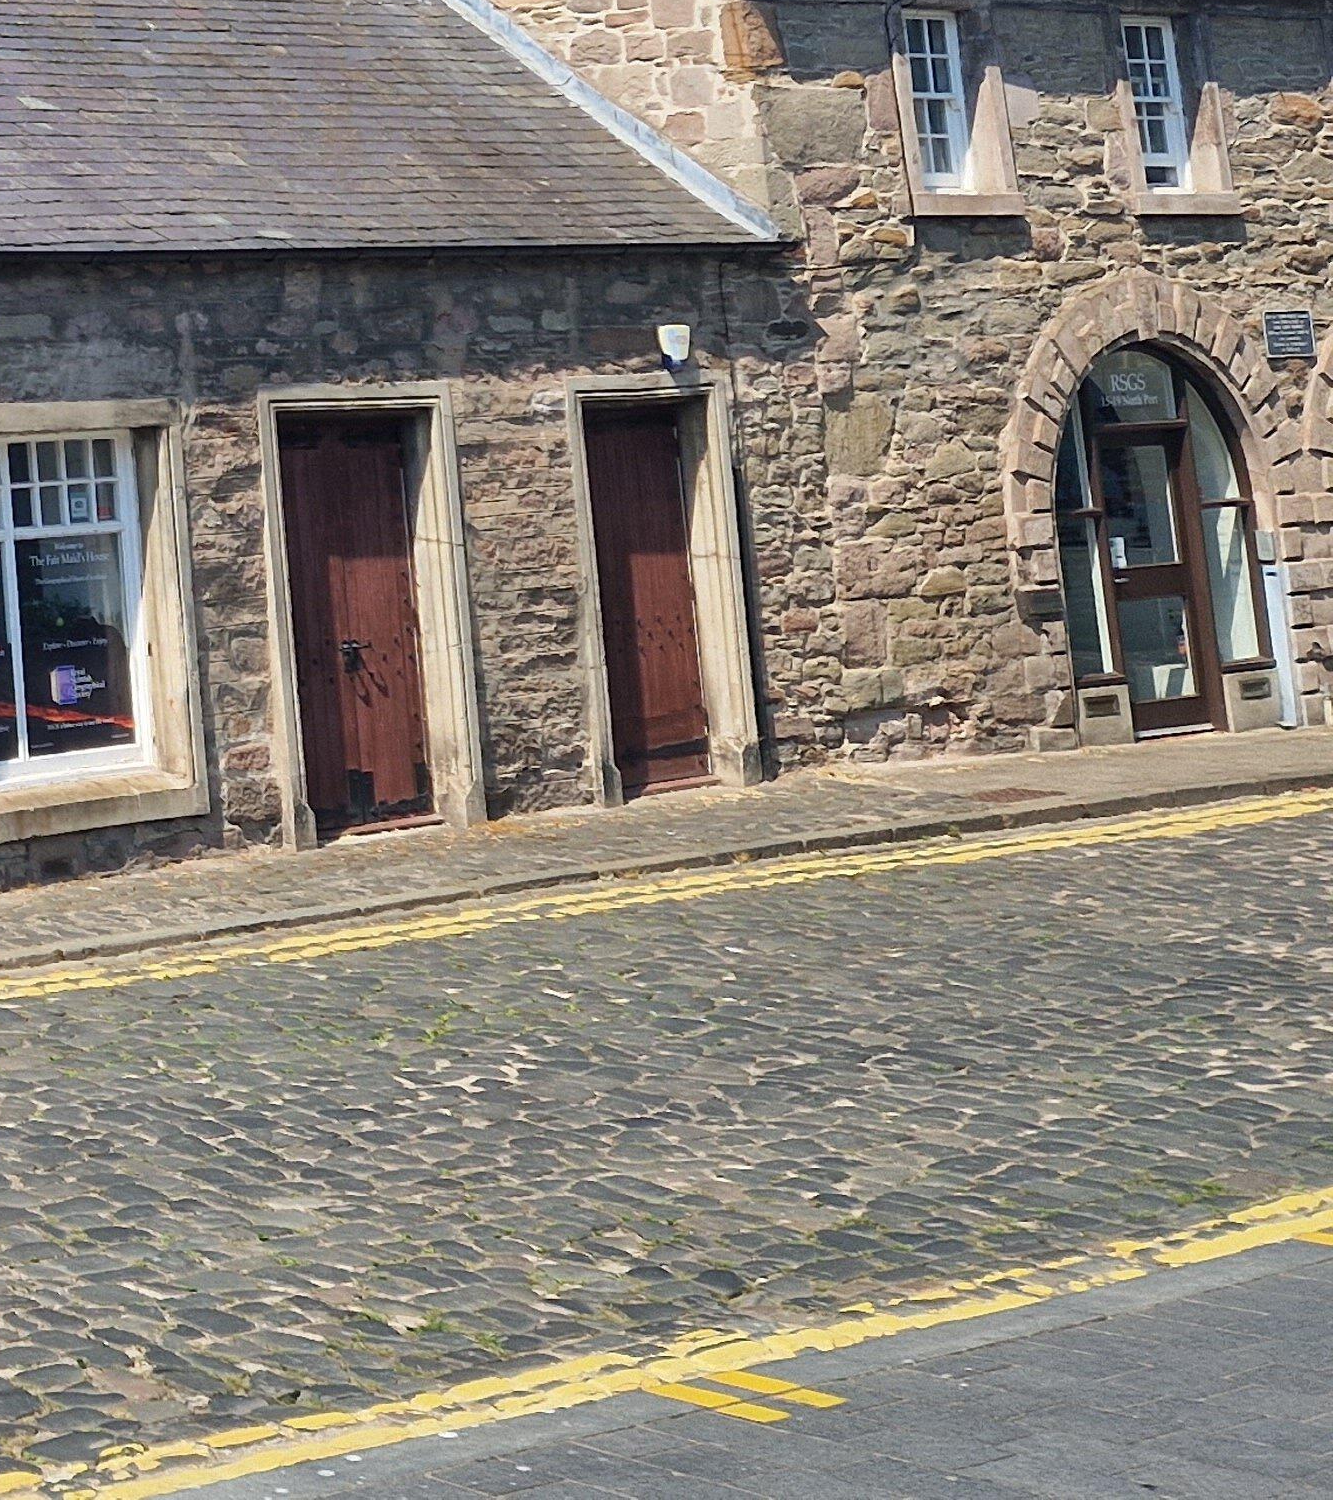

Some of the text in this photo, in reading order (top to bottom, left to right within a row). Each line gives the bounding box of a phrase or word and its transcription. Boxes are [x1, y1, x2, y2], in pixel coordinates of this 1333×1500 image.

[1110, 373, 1146, 391] RSGS
[29, 555, 44, 567] The
[46, 554, 60, 566] Fair
